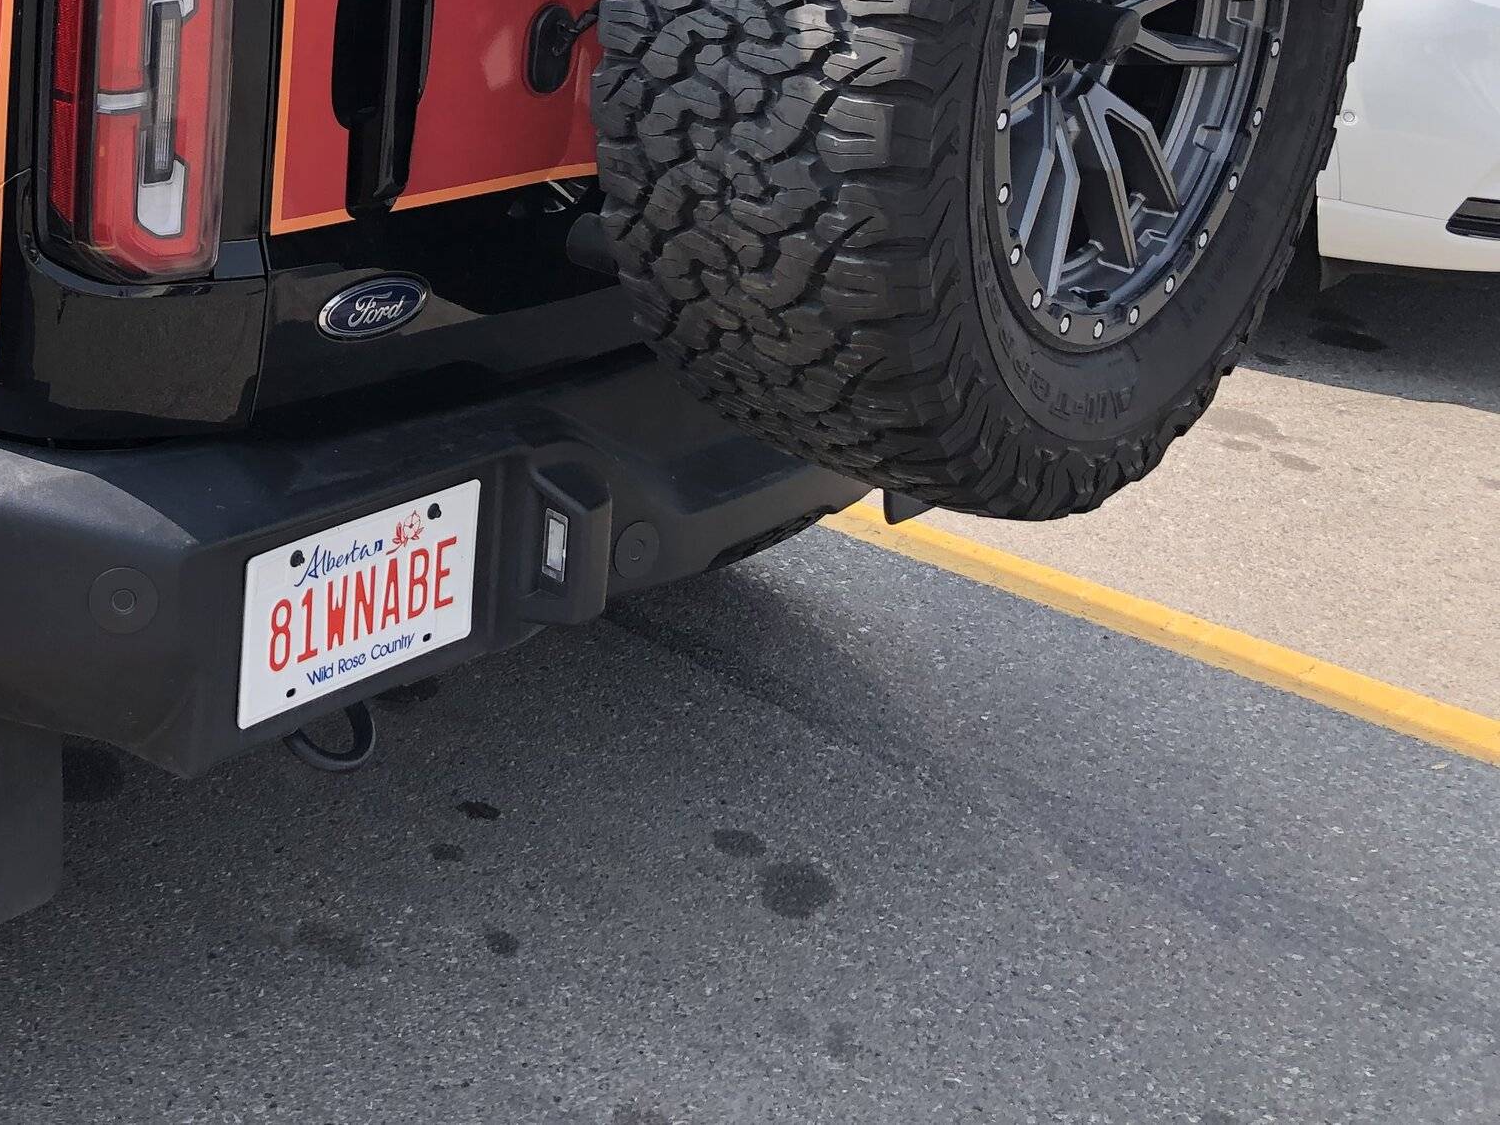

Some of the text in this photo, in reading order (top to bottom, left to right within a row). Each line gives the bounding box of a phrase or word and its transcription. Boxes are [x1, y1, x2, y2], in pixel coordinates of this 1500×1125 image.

[347, 291, 407, 328] Ford
[294, 539, 370, 588] Alberta
[268, 535, 458, 673] 81WNABE
[306, 631, 416, 686] Wild Rose Country
